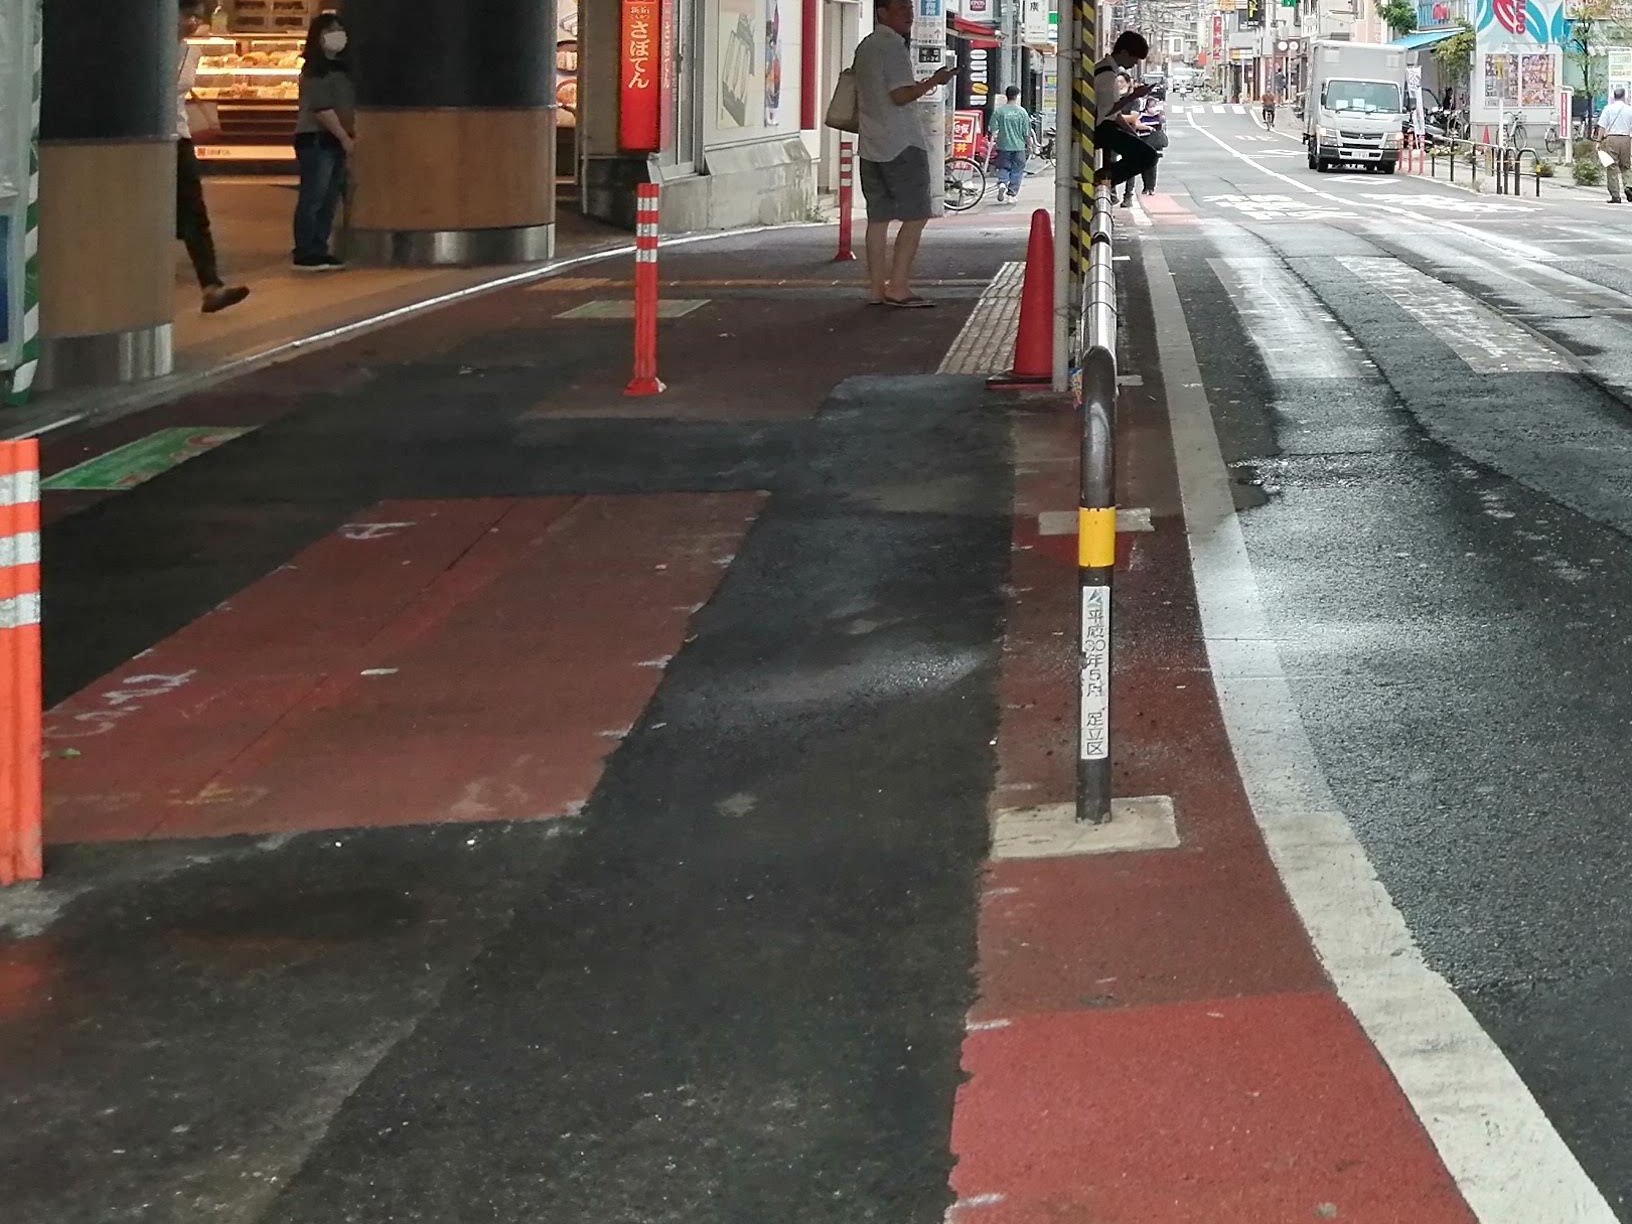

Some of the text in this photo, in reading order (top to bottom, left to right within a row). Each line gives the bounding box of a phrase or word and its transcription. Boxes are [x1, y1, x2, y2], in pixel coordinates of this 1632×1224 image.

[628, 20, 650, 89] さぼてん
[1086, 711, 1105, 756] 足立区
